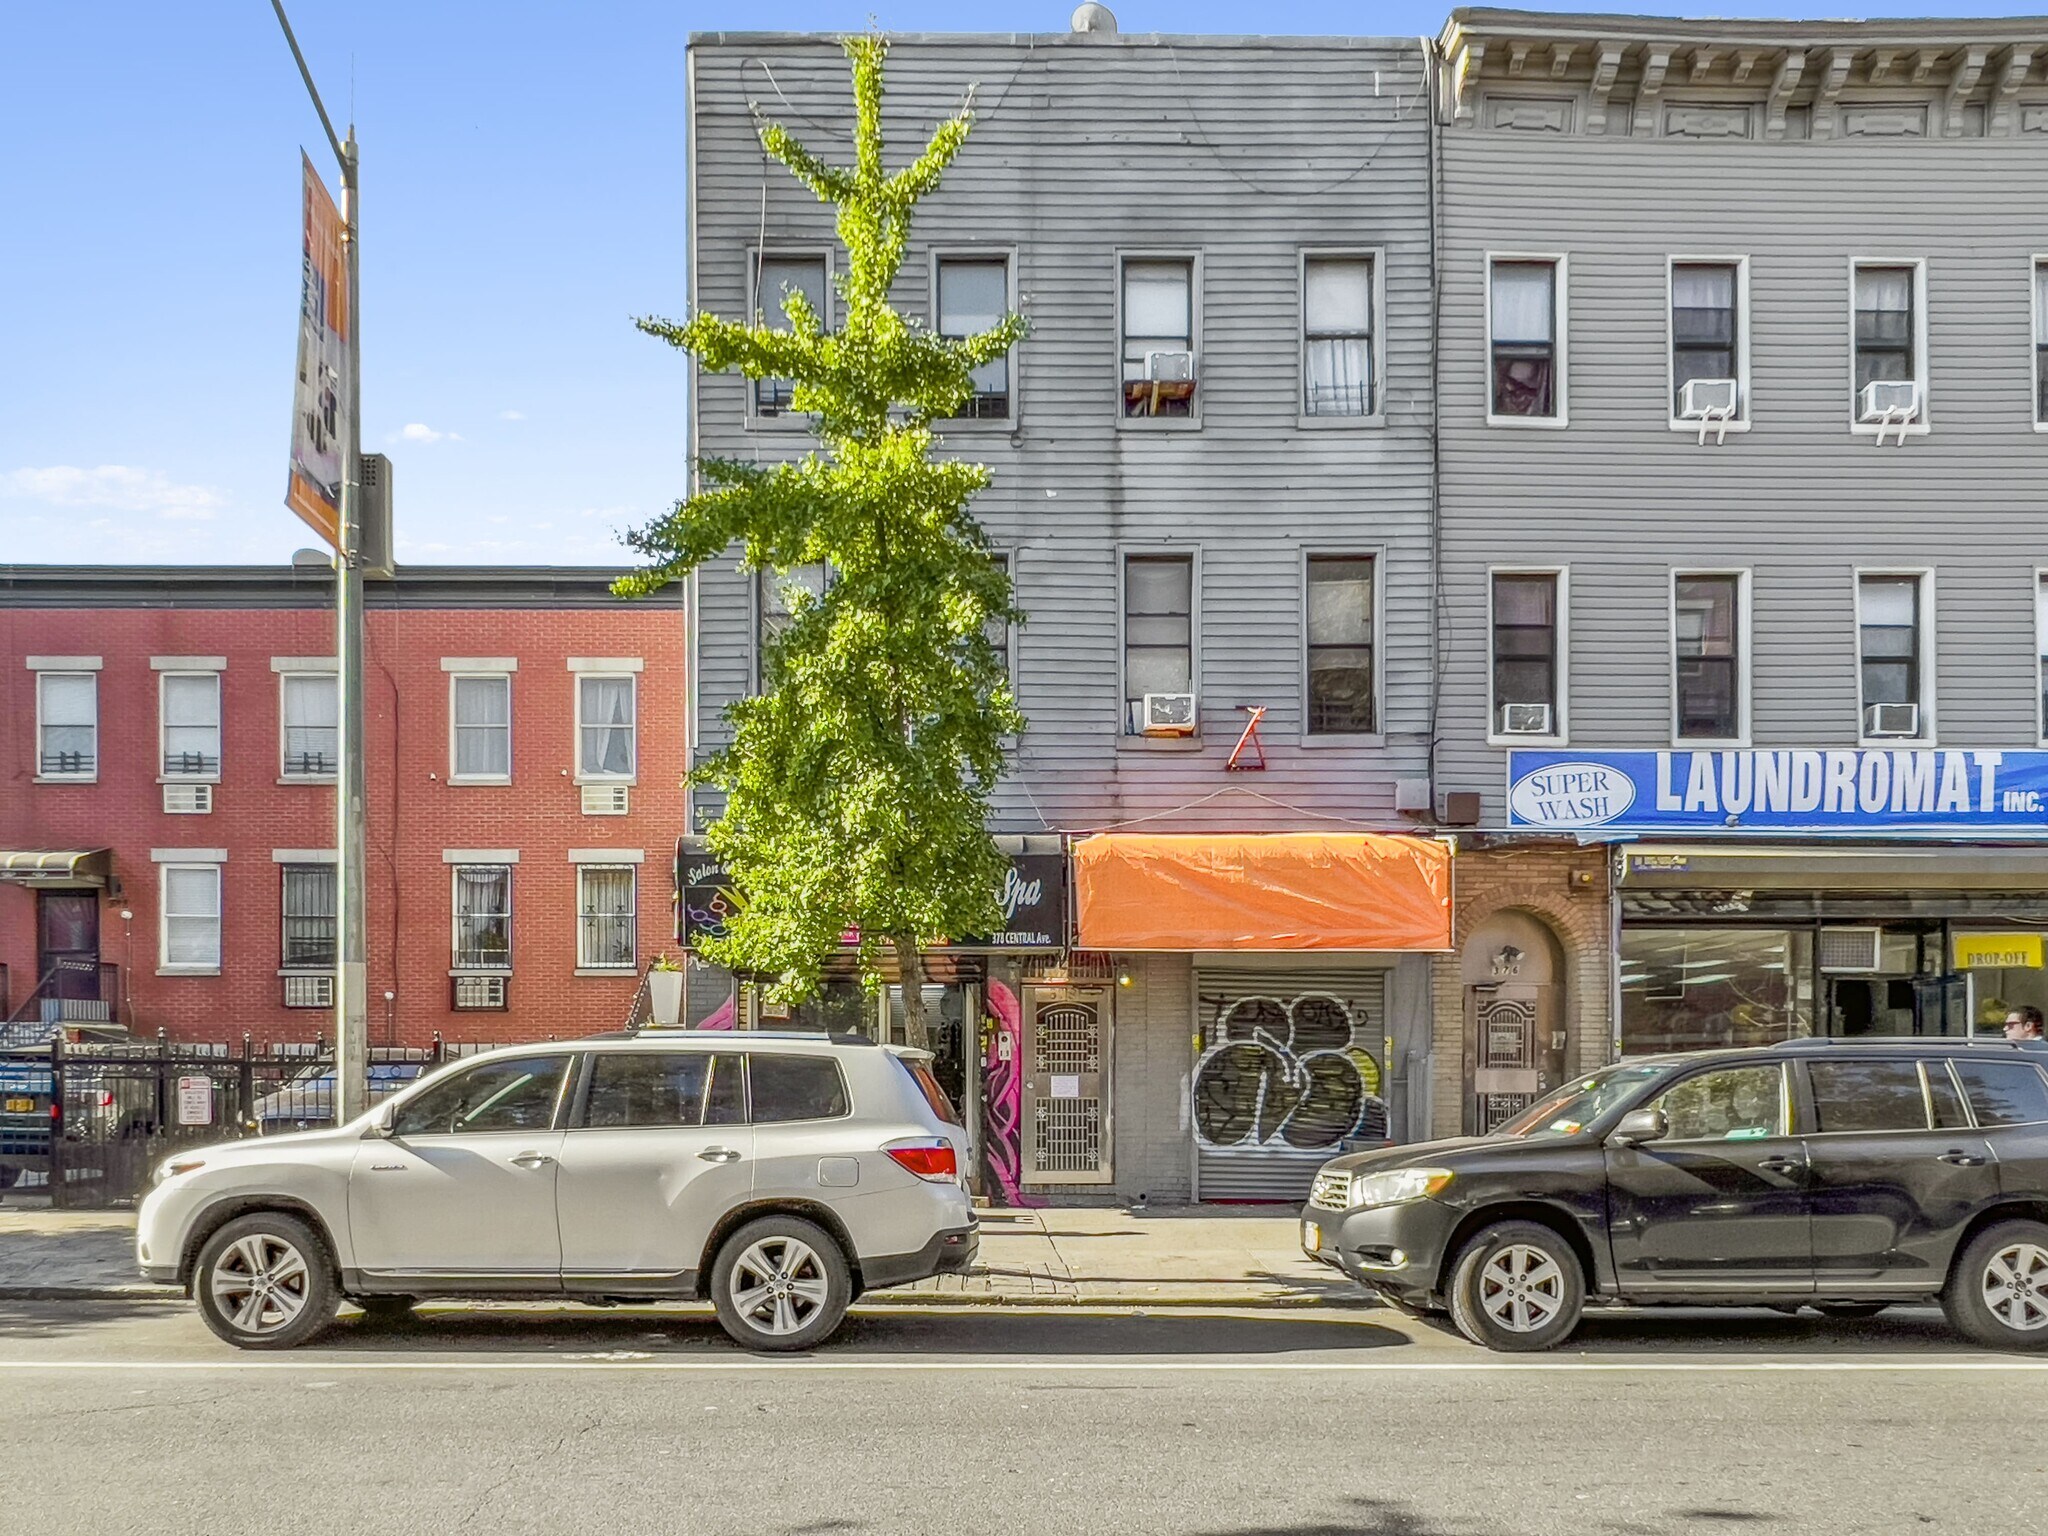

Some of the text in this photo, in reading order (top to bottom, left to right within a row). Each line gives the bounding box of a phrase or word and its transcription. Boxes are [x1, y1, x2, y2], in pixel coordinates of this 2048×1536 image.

[1531, 771, 1610, 797] SUPER
[1655, 751, 2045, 815] LAUNDROMAT INC.
[1537, 796, 1611, 820] WASH
[687, 863, 719, 886] Salon
[993, 866, 1042, 919] Spa
[1005, 932, 1036, 944] CENTRAL
[1967, 951, 2028, 965] DROP-OFF
[1493, 965, 1518, 976] 376
